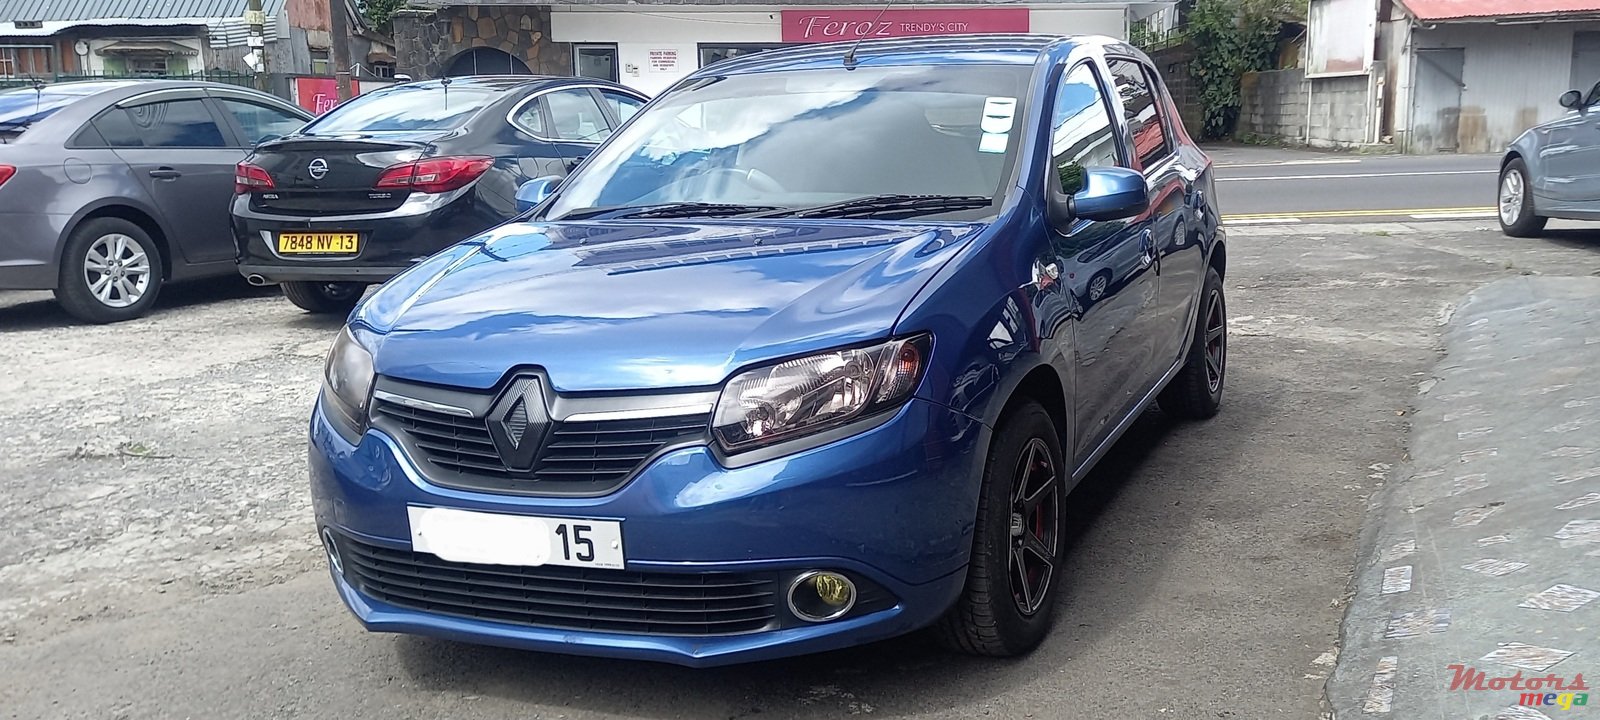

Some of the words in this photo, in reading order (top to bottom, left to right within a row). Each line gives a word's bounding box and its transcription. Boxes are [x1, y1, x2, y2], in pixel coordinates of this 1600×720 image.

[799, 16, 893, 38] Feroz
[900, 22, 945, 33] TRENDY'S
[948, 22, 969, 32] CITY
[313, 94, 337, 115] Fer
[282, 235, 313, 250] 7848
[317, 235, 333, 249] NV
[555, 524, 595, 562] 15
